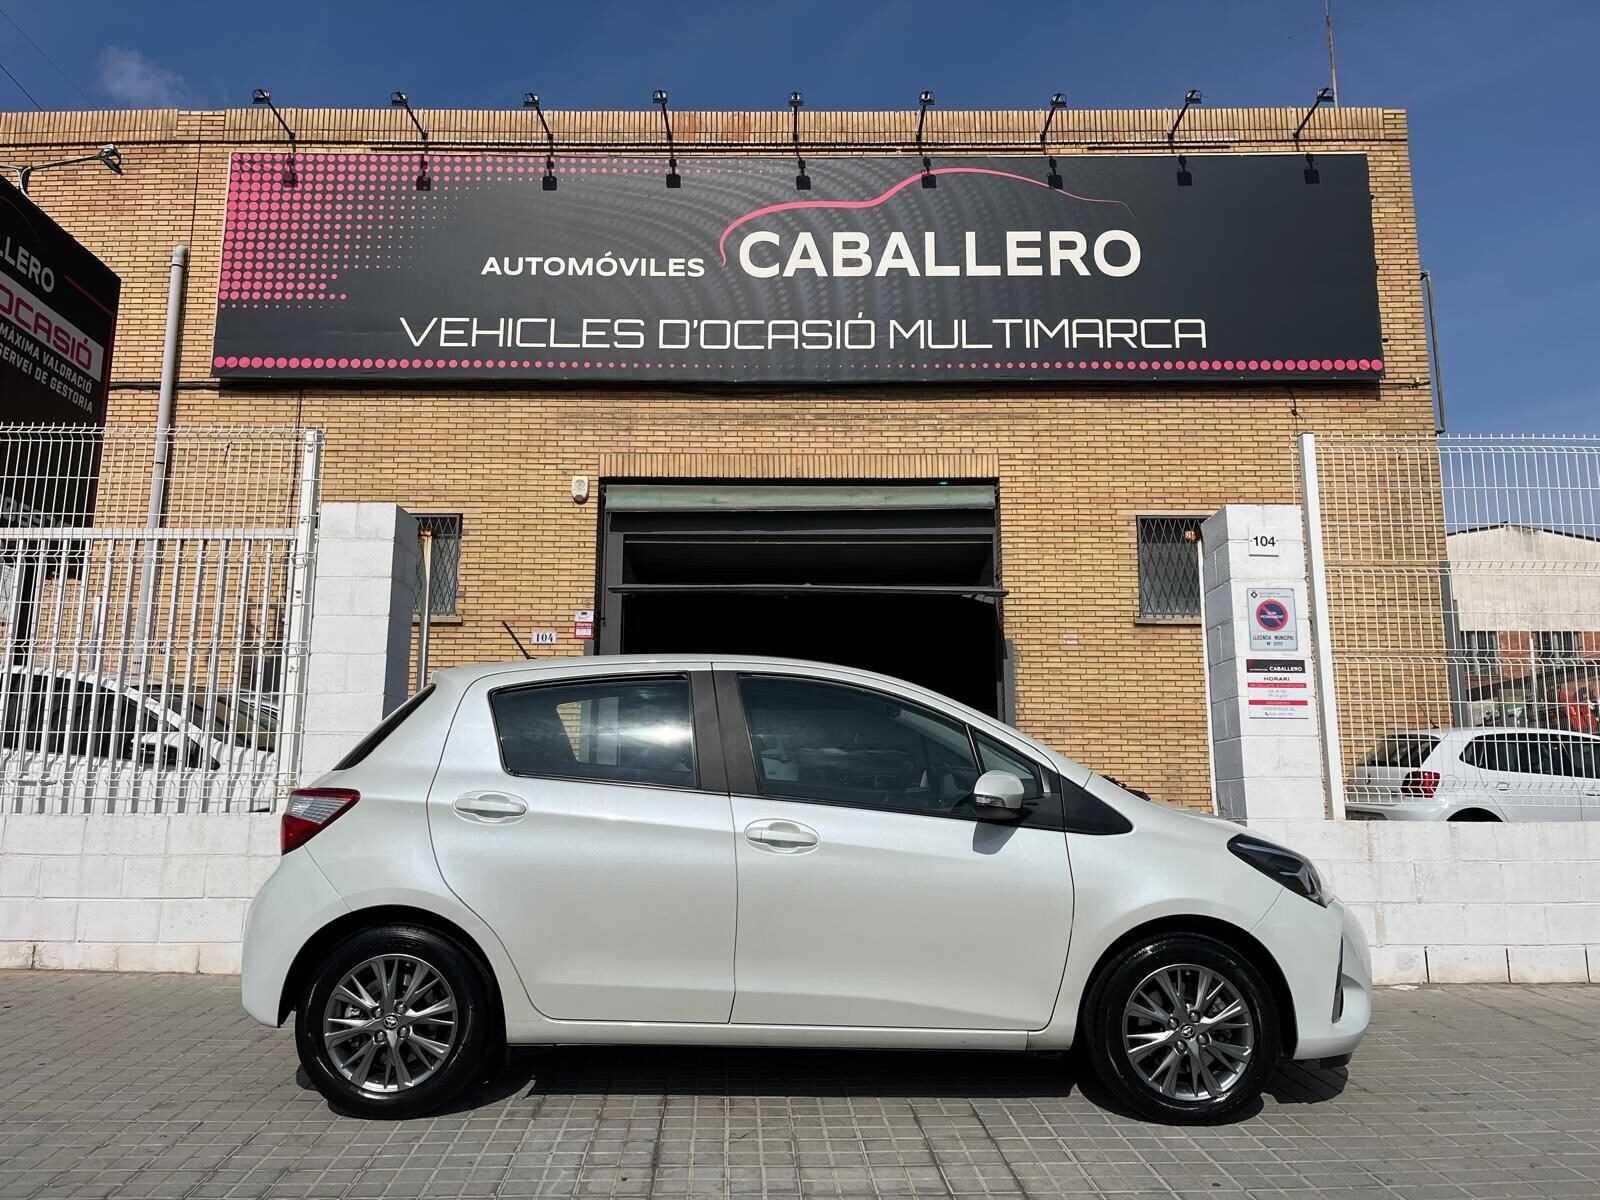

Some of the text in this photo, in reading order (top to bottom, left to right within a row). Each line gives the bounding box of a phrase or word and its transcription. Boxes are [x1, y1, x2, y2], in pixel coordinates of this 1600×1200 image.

[0, 236, 55, 293] LERO
[481, 229, 1141, 278] AUTOMÓVILES CABALLERO
[400, 311, 1207, 350] VEHICLES D'OCASIÓ MULTIMARCA
[34, 367, 48, 385] DE
[49, 377, 93, 414] GESTORIA
[43, 351, 93, 394] VALORACIÓ
[1253, 535, 1276, 547] 104
[536, 633, 553, 643] 104
